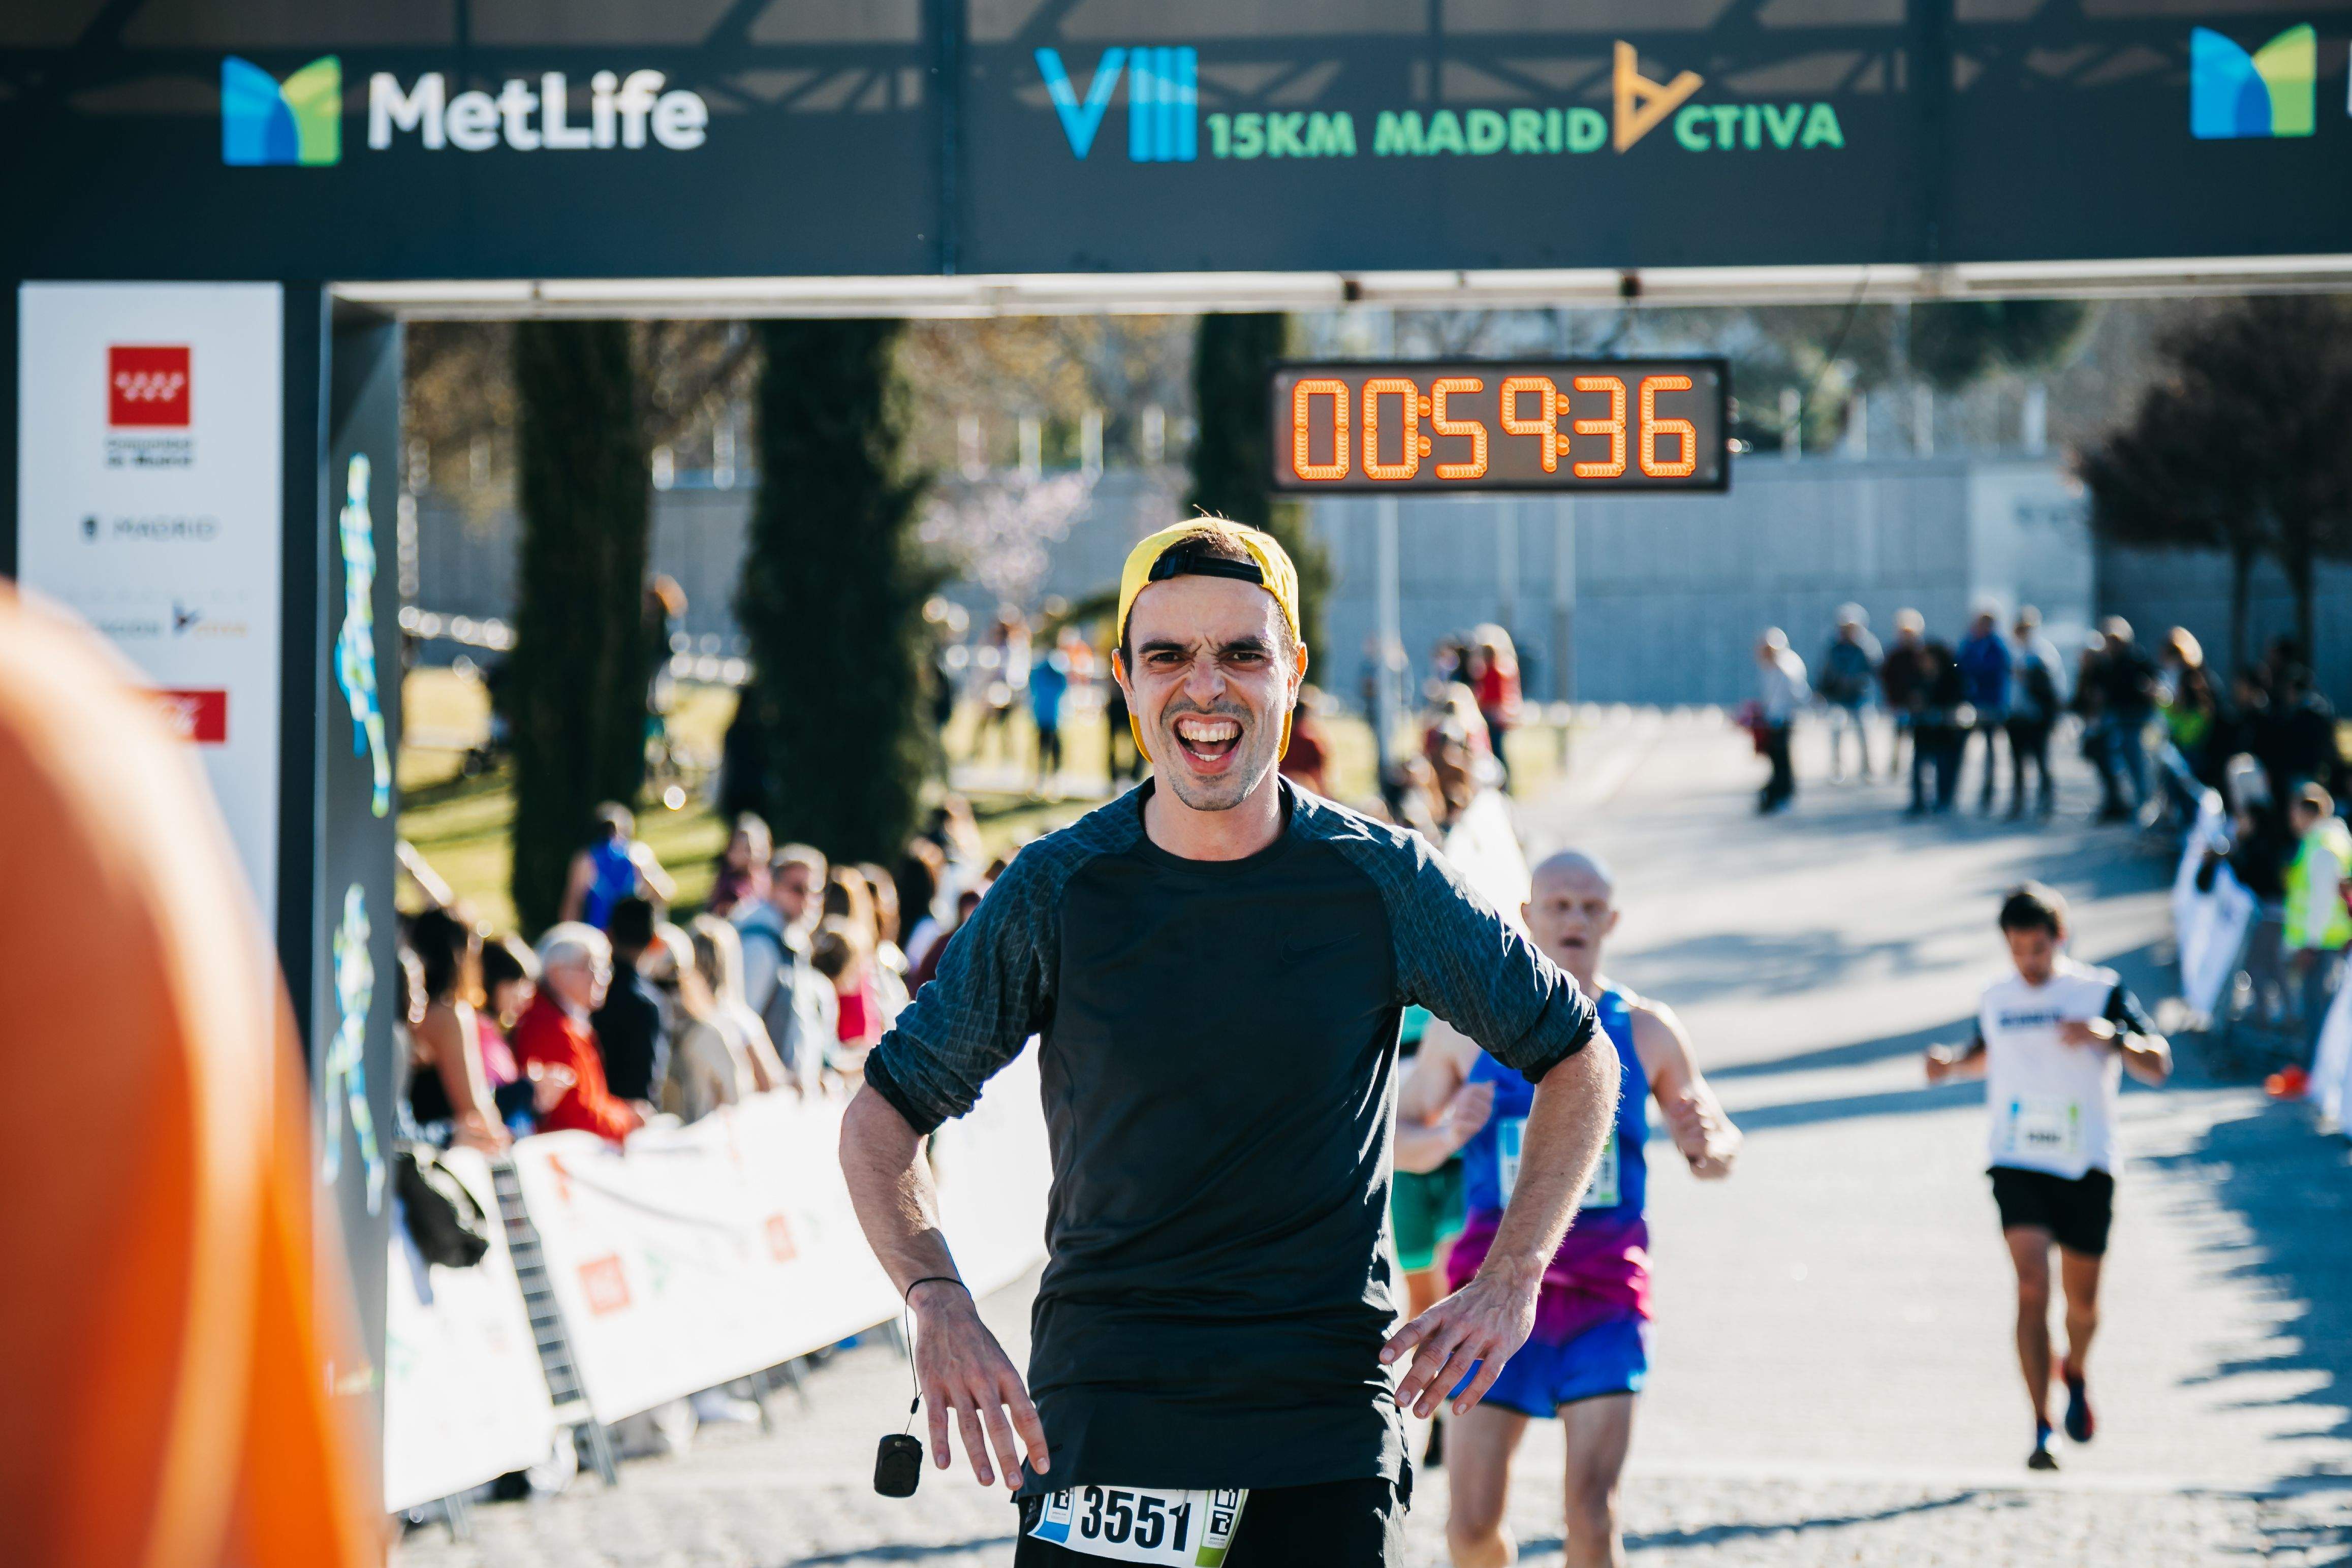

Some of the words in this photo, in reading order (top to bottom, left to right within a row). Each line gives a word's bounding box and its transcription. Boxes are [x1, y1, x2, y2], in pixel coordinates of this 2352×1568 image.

[368, 69, 709, 151] MetLife
[1035, 47, 1198, 162] VIII
[1206, 111, 1357, 160] 15KM
[1373, 107, 1608, 157] MADRID
[1292, 375, 1697, 480] 00:59:36
[1080, 1485, 1191, 1552] 3551
